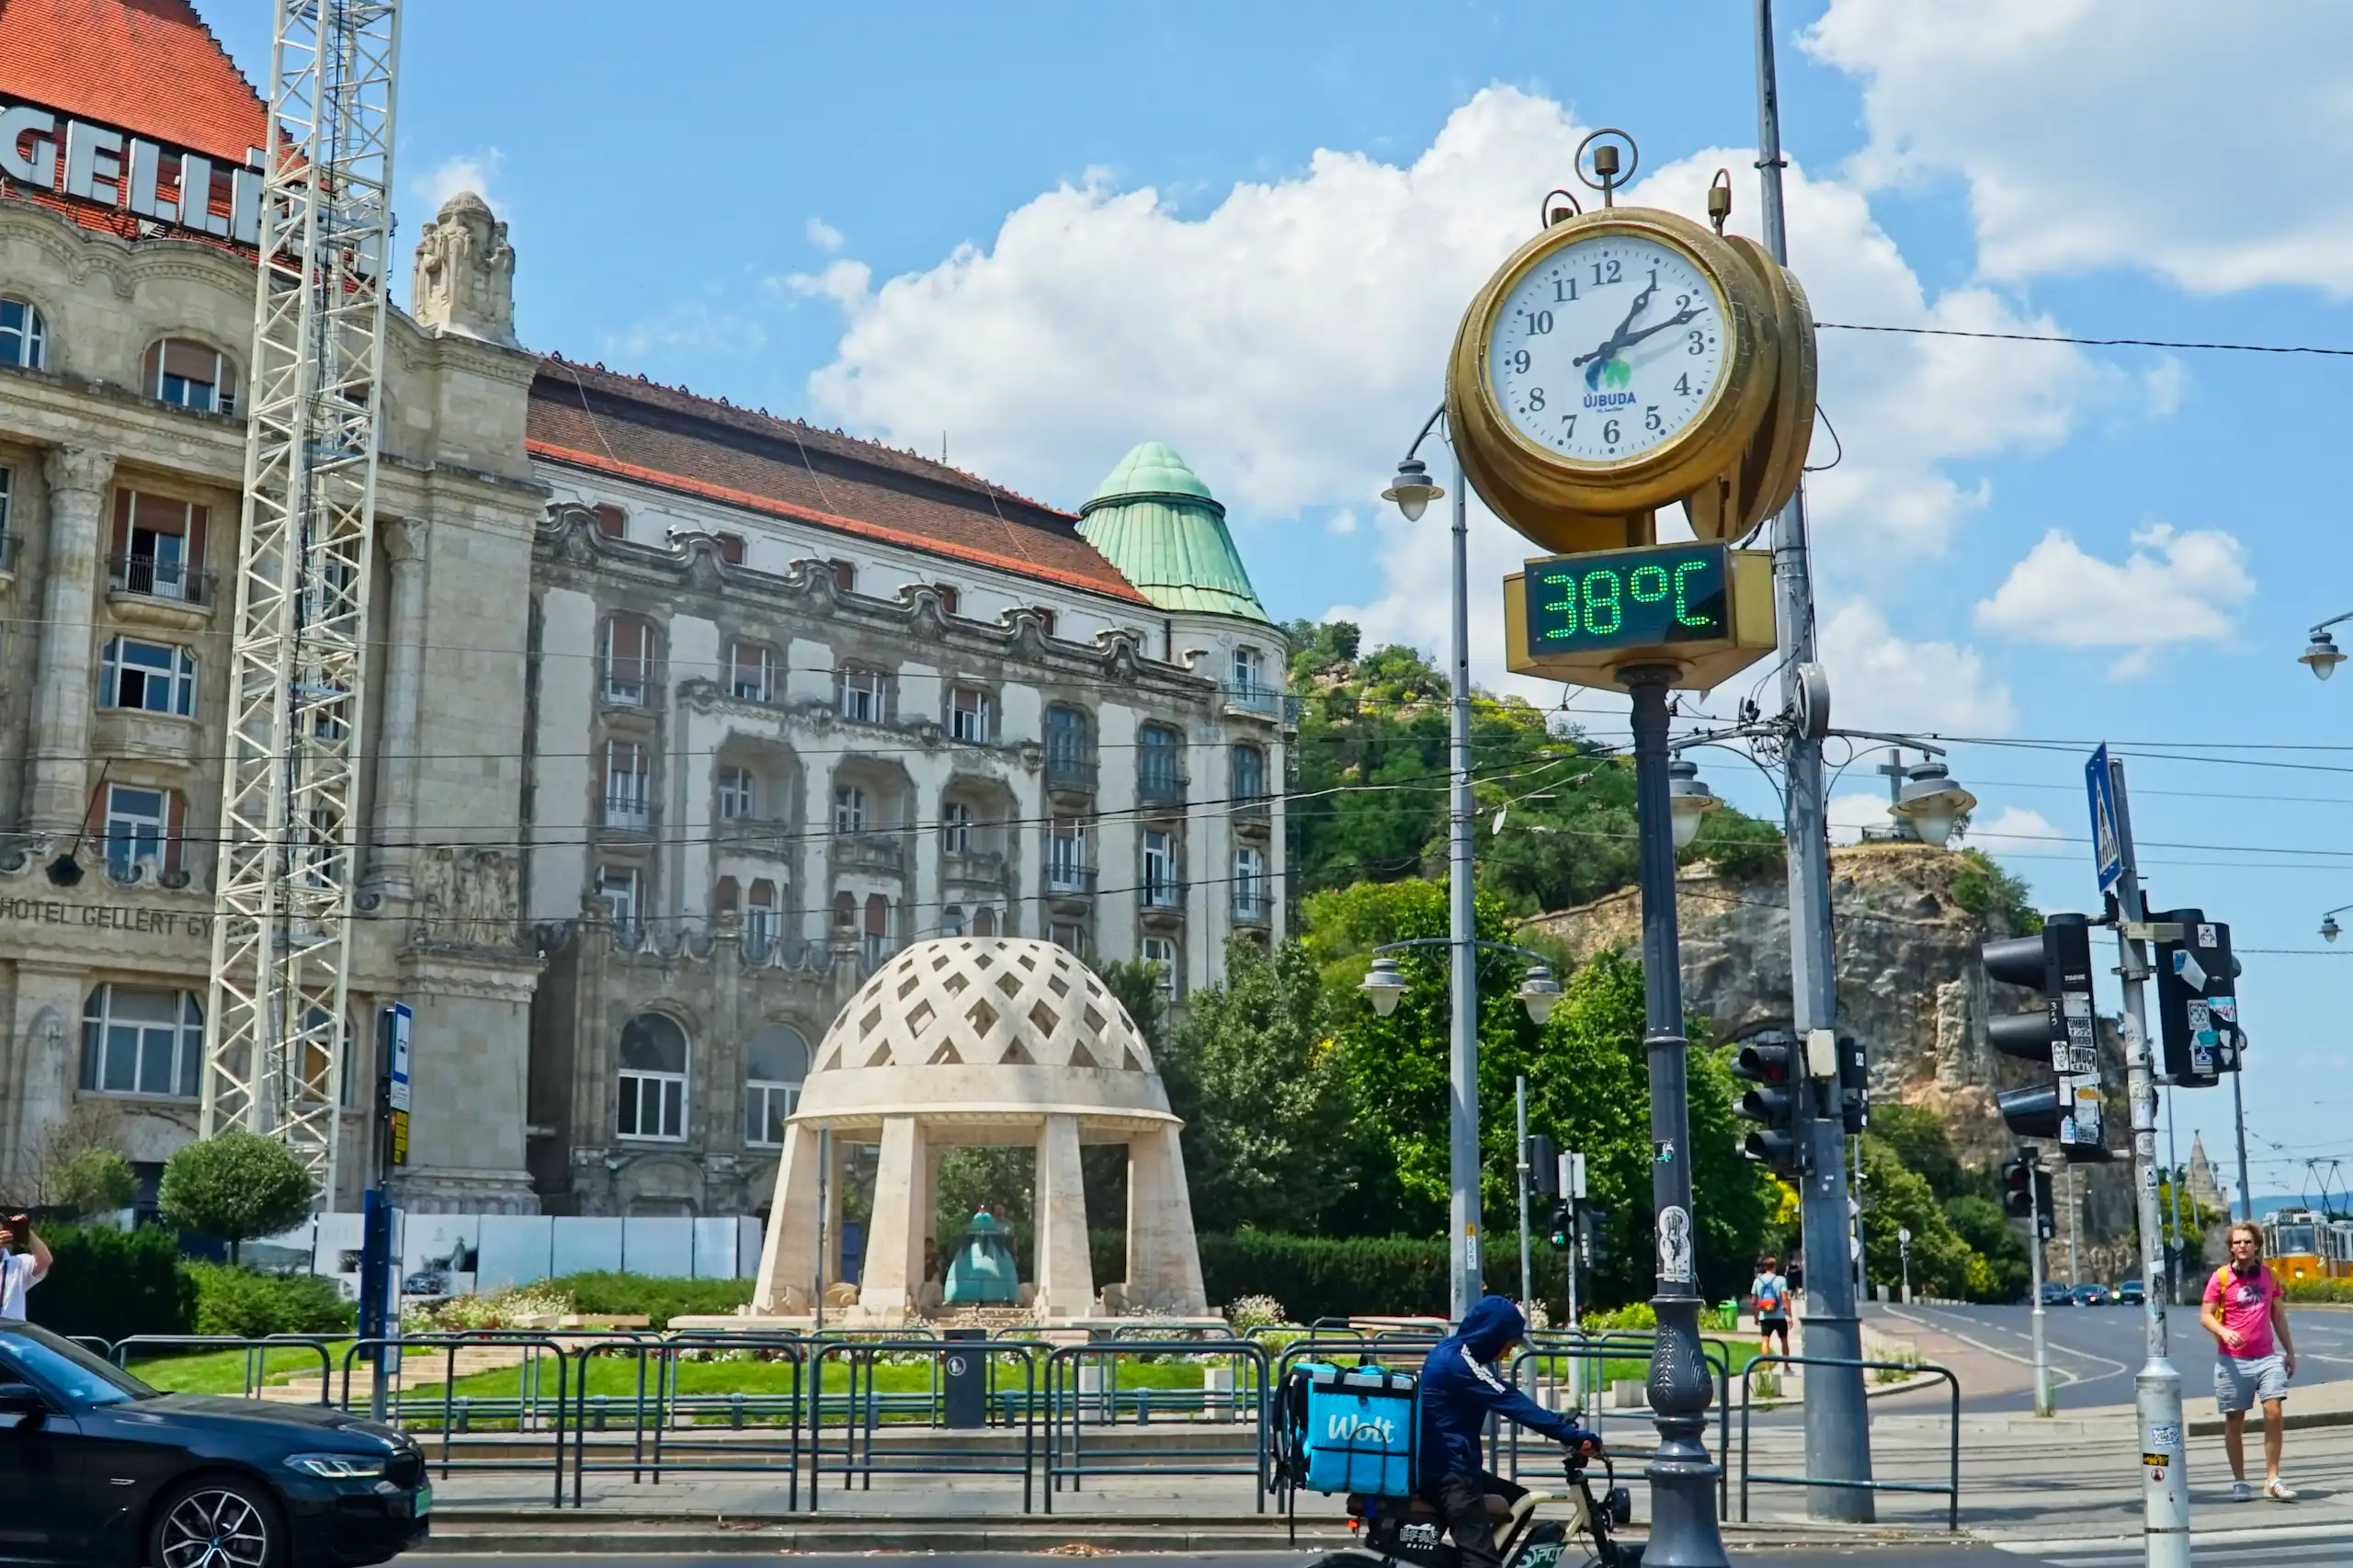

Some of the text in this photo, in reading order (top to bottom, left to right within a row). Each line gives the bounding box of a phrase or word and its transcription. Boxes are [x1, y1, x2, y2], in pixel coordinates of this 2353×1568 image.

[1591, 260, 1622, 286] 12
[1646, 269, 1661, 291] 1
[1552, 278, 1580, 302] 11
[1676, 294, 1692, 316] 2
[1526, 310, 1553, 335] 10
[1688, 331, 1704, 355] 3
[1514, 350, 1531, 374] 9
[1674, 372, 1690, 396] 4
[1529, 387, 1545, 411] 8
[1584, 392, 1636, 408] ÚJBUDA
[1562, 415, 1577, 438] 7
[1645, 405, 1662, 429] 5
[1604, 419, 1620, 443] 6
[1543, 561, 1710, 639] 38°C
[0, 897, 71, 924] HOTEL
[84, 905, 177, 935] GELLÉRT
[1328, 1414, 1395, 1444] Wolt
